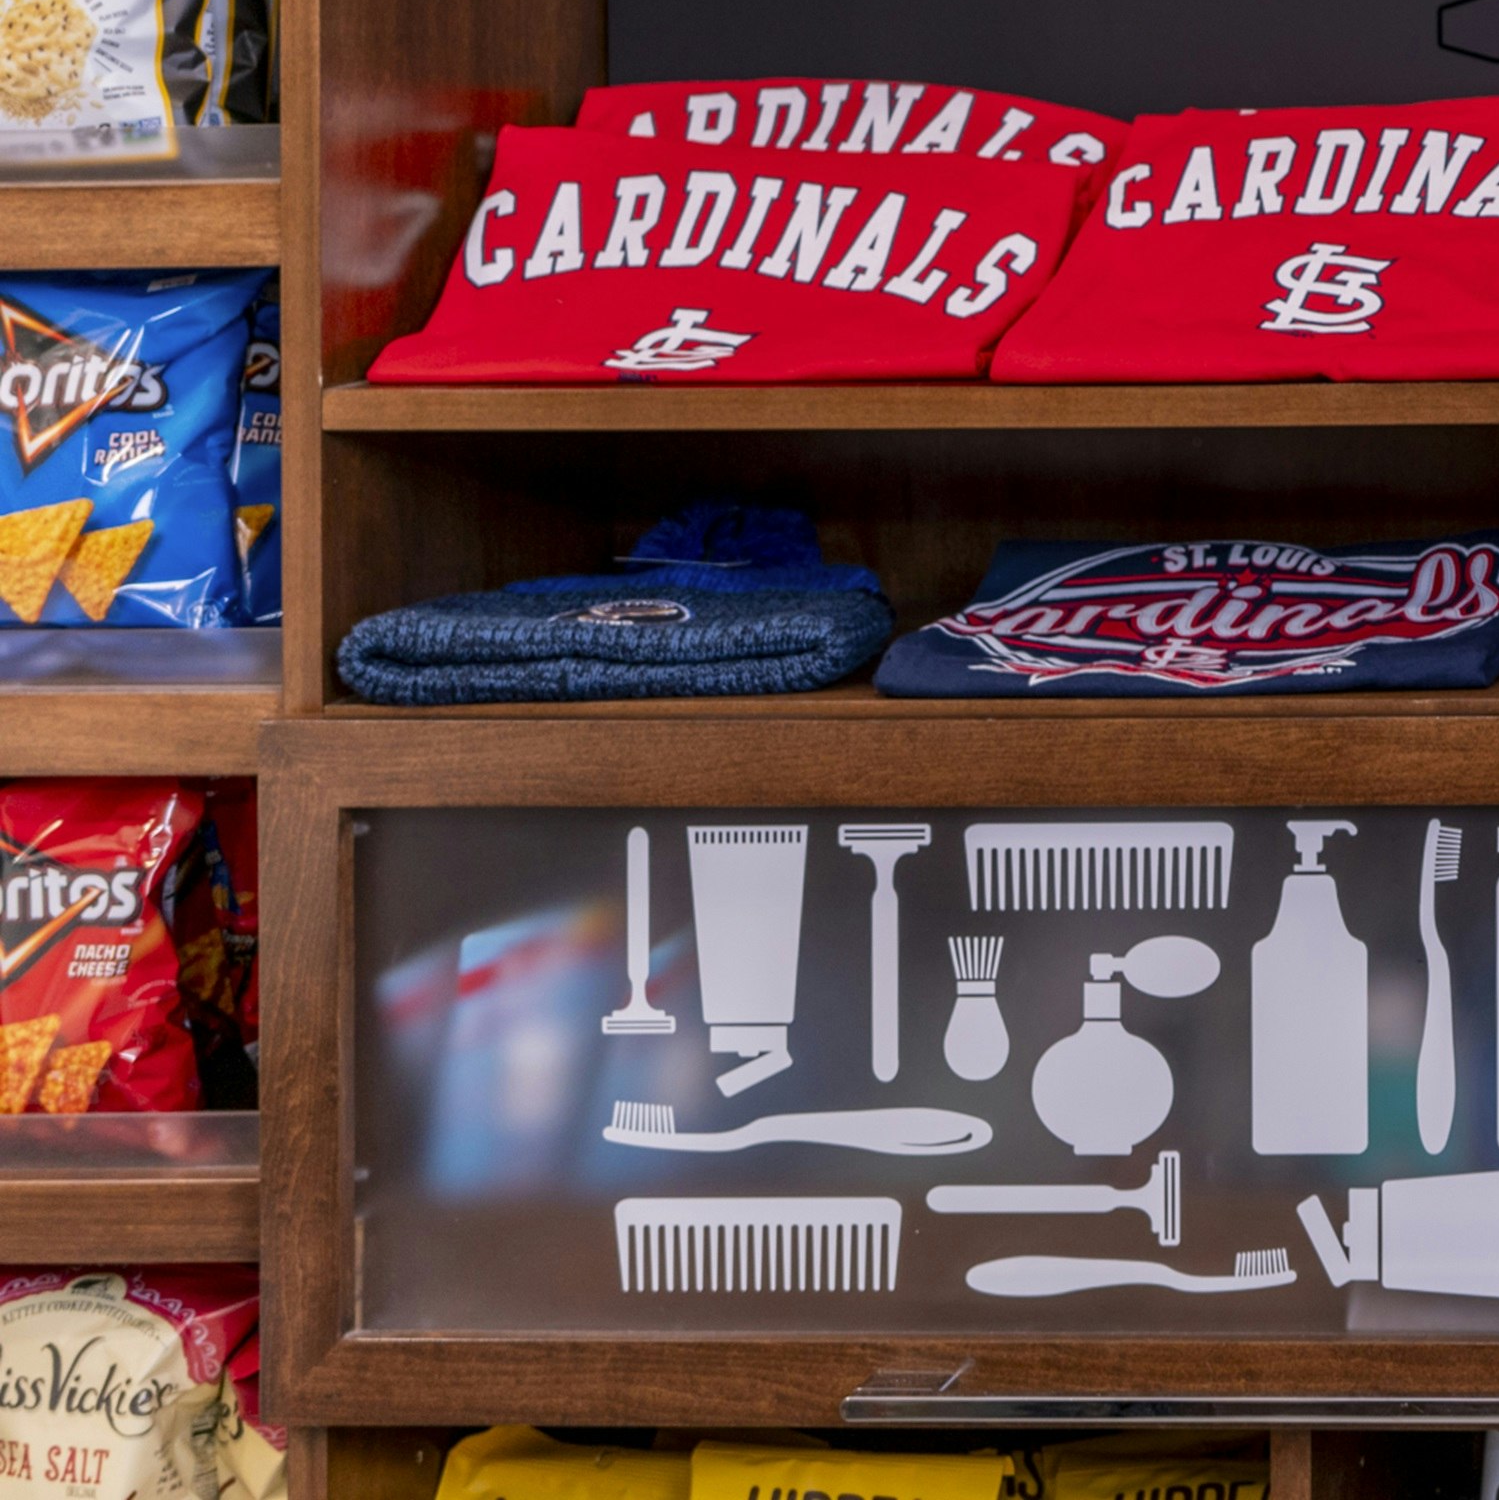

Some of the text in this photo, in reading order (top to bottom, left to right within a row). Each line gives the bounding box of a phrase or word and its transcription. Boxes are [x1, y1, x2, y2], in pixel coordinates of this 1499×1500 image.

[463, 170, 1037, 318] CARDINALS
[0, 355, 166, 408] oritos
[108, 430, 160, 447] COOL
[1162, 542, 1337, 576] ST. LOUIS
[74, 944, 131, 960] NACHO
[68, 961, 128, 978] CHEESE
[0, 1439, 110, 1485] SEA SALT
